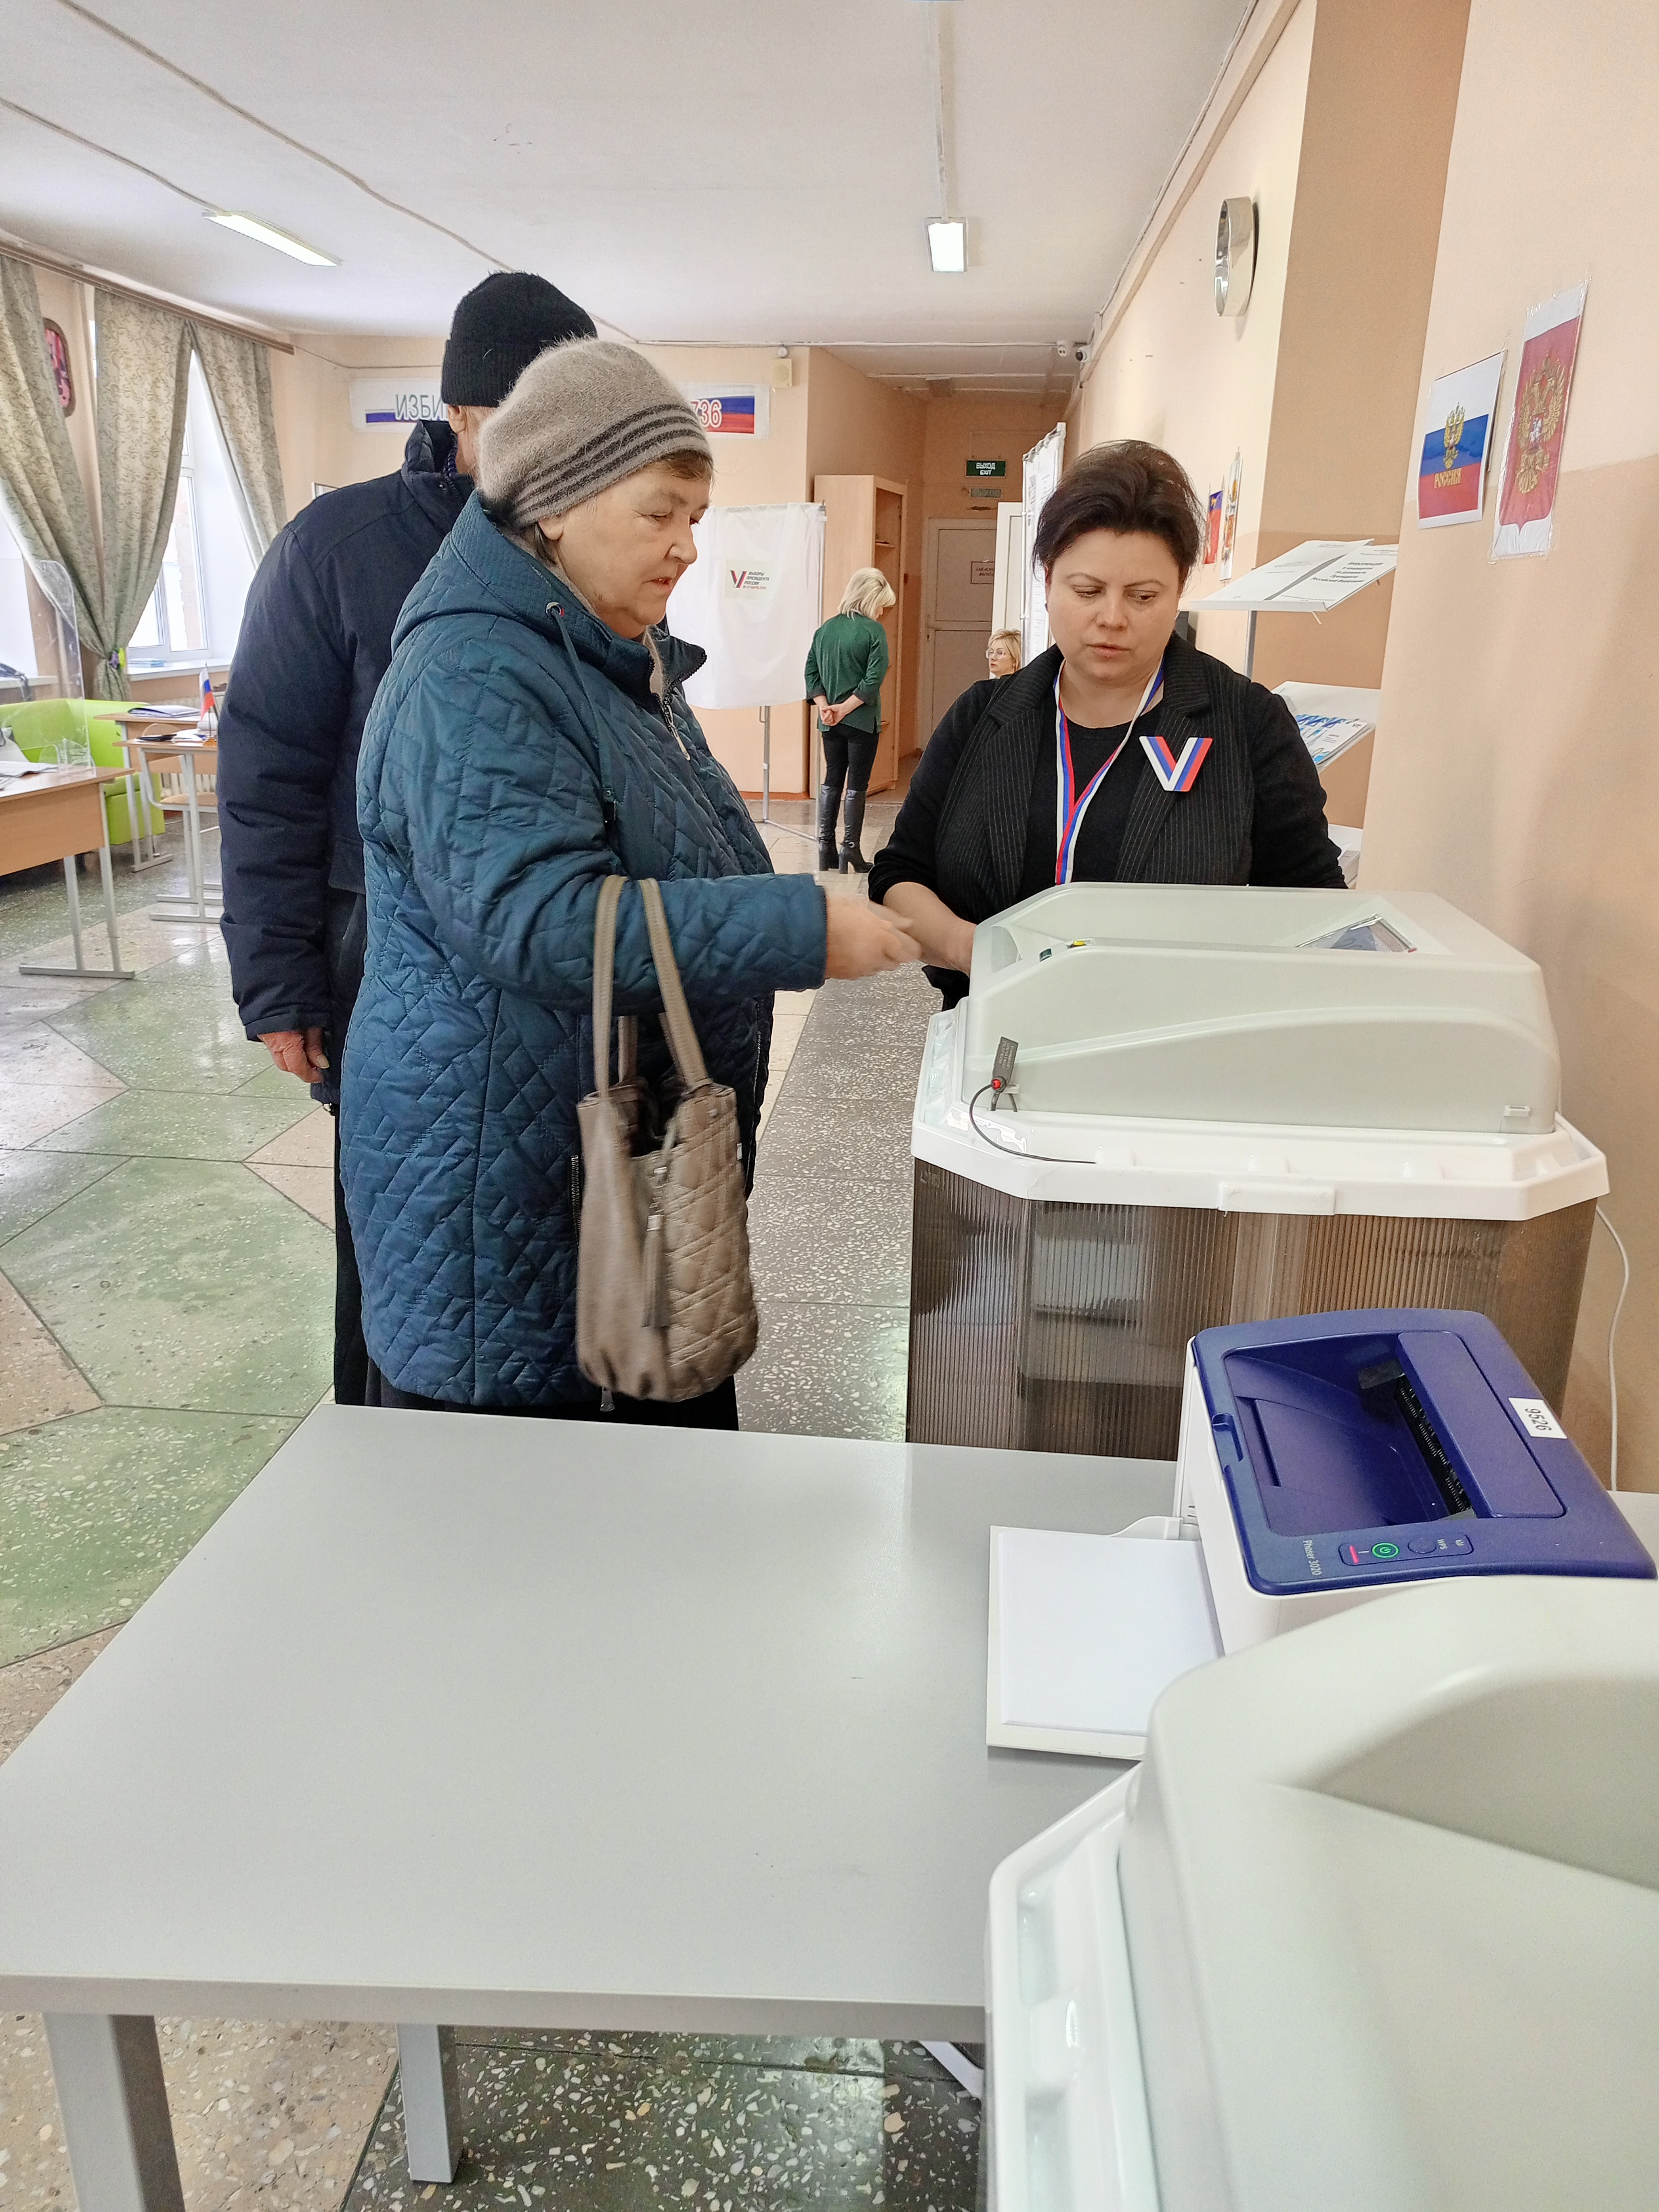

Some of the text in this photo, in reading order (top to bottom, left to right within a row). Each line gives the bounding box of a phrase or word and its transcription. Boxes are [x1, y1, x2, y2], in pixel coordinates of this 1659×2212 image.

[395, 394, 444, 419] ИЗБИ
[1433, 467, 1462, 489] РОССИЯ
[1525, 1408, 1552, 1431] 9526
[1437, 1539, 1448, 1550] WPS
[1302, 1539, 1322, 1575] Phaser 3020
